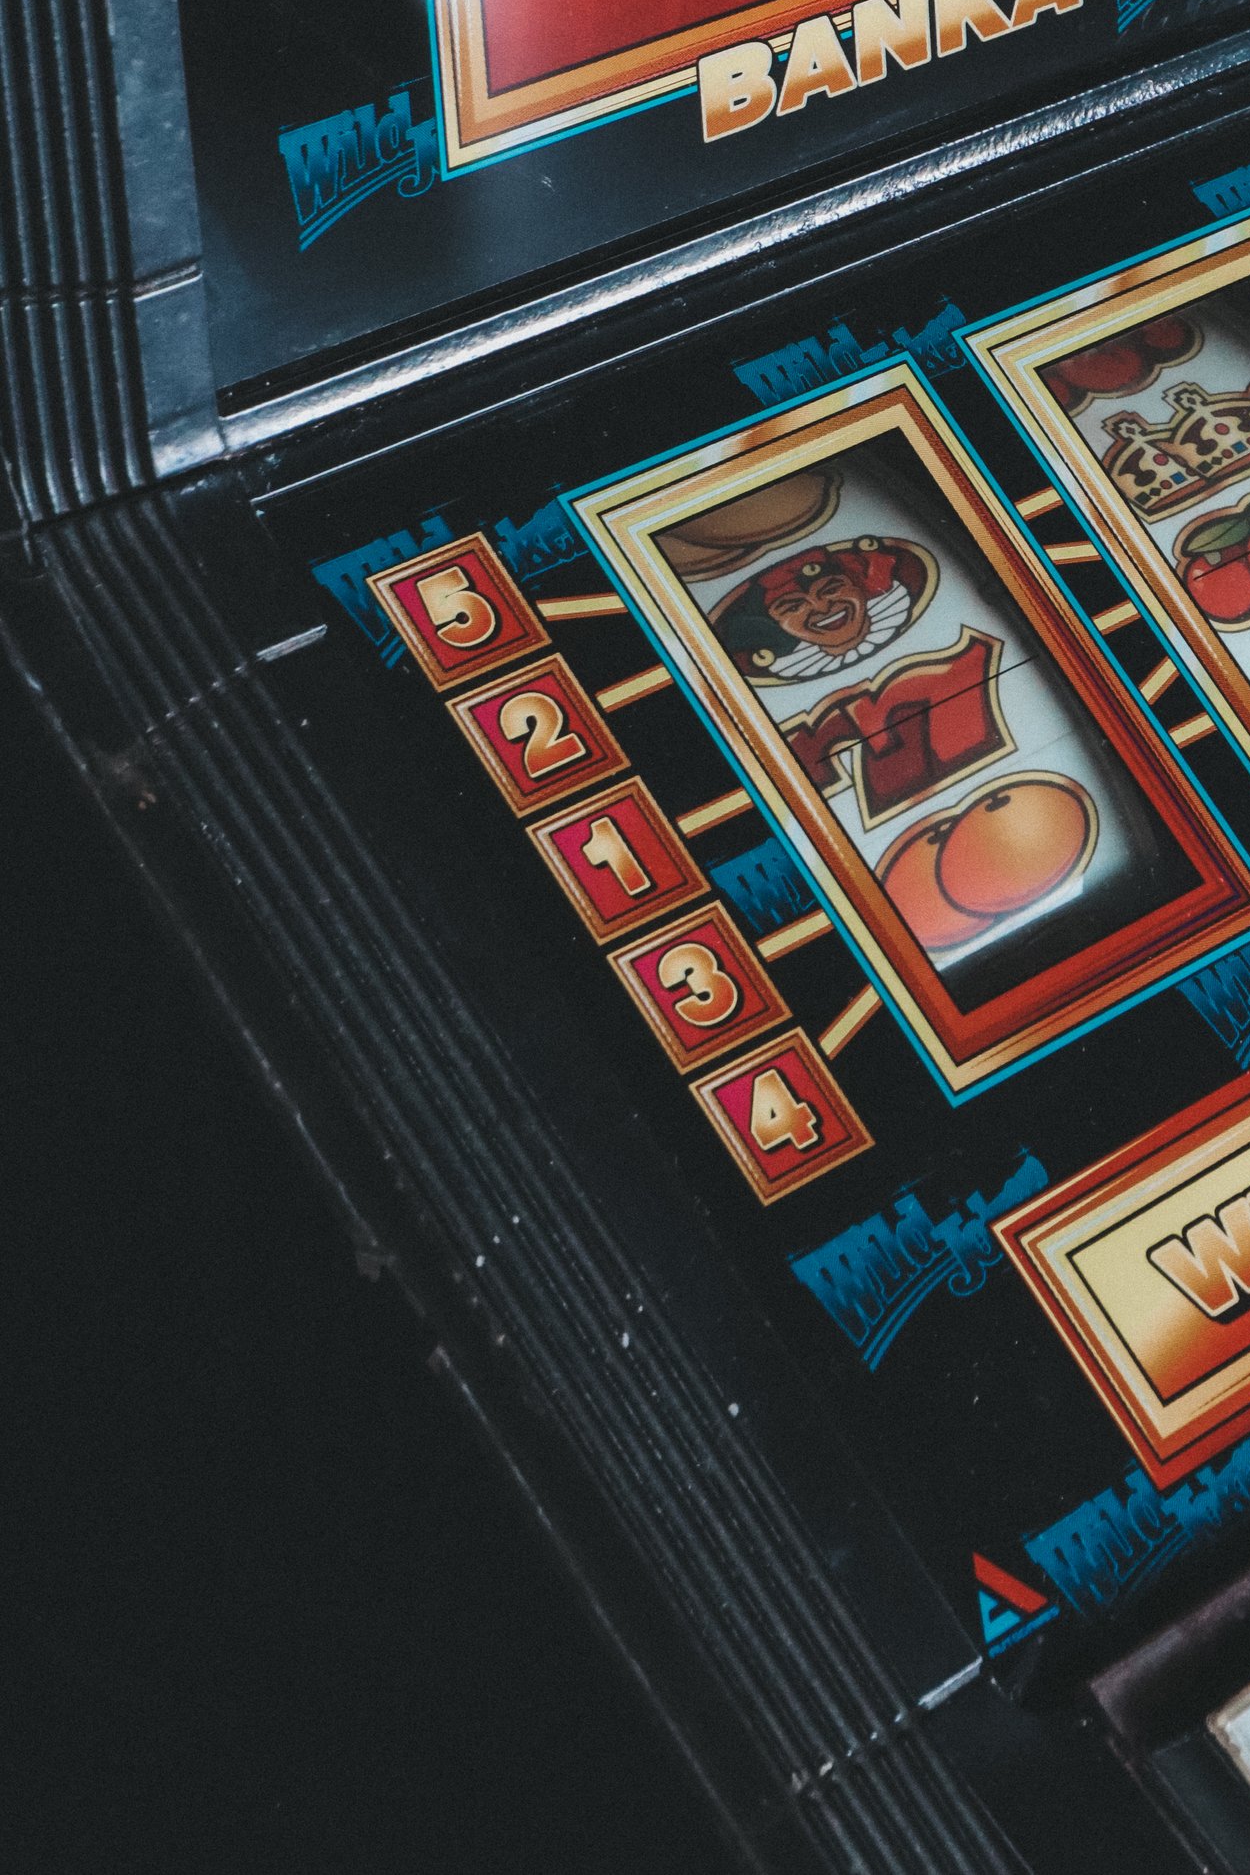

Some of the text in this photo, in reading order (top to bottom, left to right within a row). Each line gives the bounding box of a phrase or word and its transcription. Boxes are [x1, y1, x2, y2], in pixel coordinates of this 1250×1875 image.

[278, 90, 414, 227] Wild
[416, 565, 497, 648] 5
[497, 690, 587, 778] 2
[581, 816, 652, 896] 1
[656, 942, 740, 1027] 3
[749, 1068, 820, 1151] 4
[791, 1193, 940, 1349] Wild
[1023, 1468, 1168, 1618] Wild
